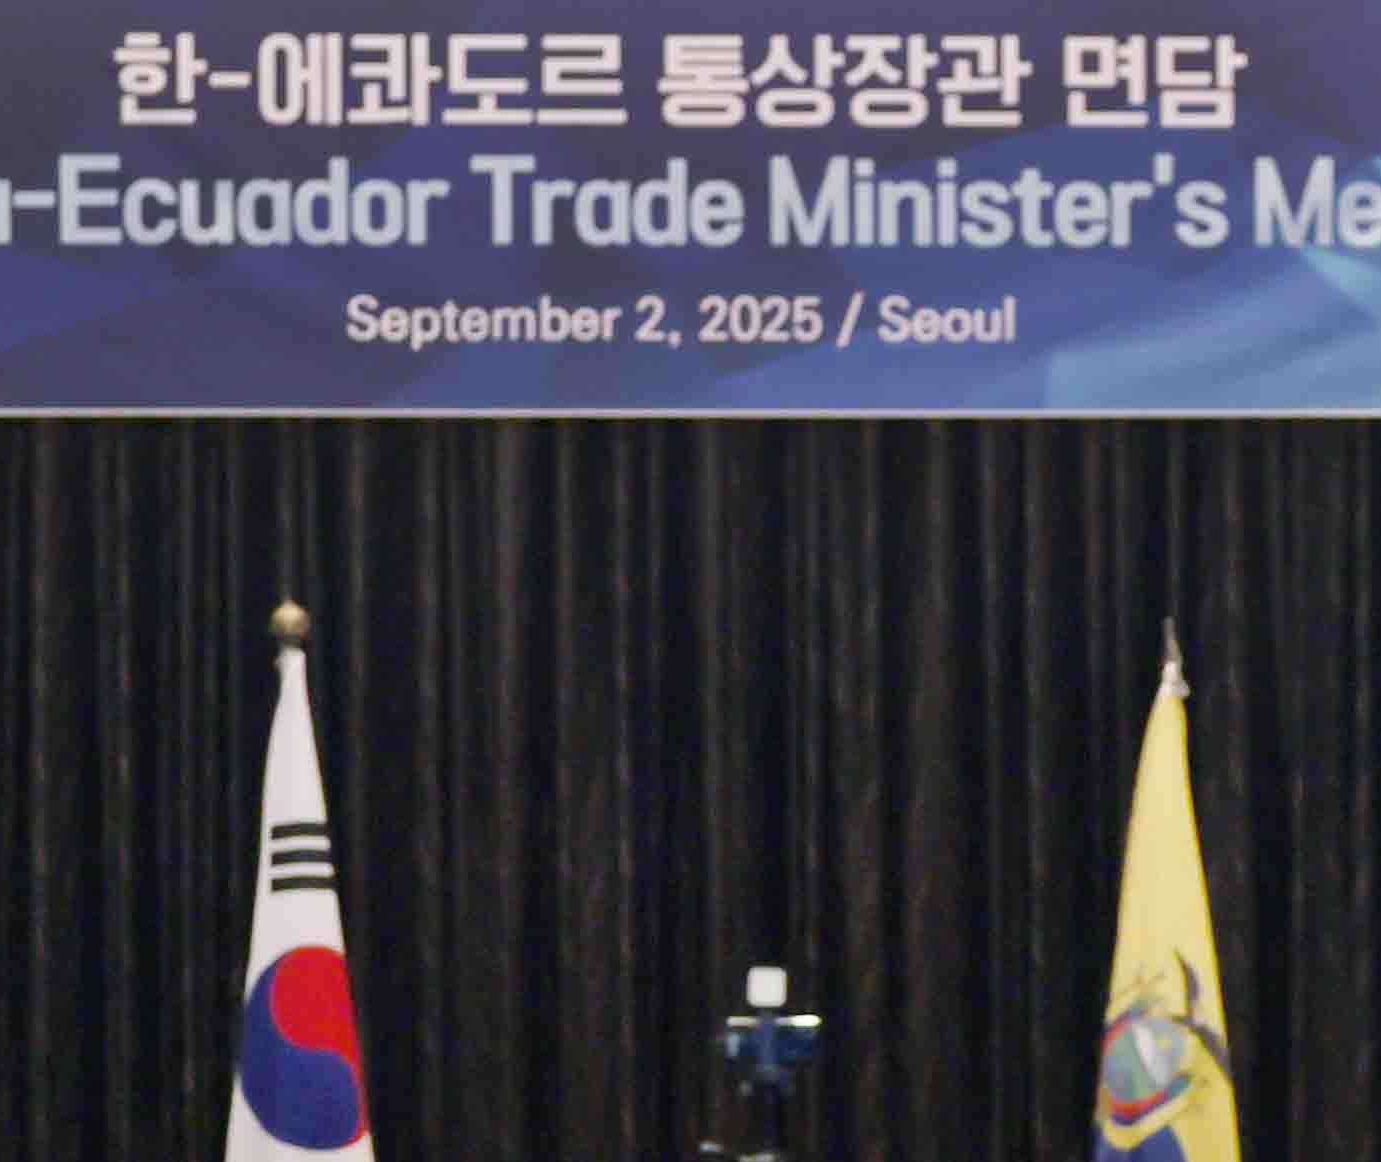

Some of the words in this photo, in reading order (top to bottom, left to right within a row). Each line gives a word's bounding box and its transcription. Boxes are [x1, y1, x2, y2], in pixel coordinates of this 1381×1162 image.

[113, 32, 628, 127] 한-에콰도르
[657, 34, 1033, 128] 통상장관
[1061, 34, 1250, 129] 면담
[470, 154, 744, 247] Trade
[770, 152, 1228, 247] Minister's
[346, 293, 622, 352] September
[635, 294, 682, 348] 2,
[698, 294, 824, 343] 2025
[836, 291, 864, 348] /
[877, 294, 1017, 343] Seoul
